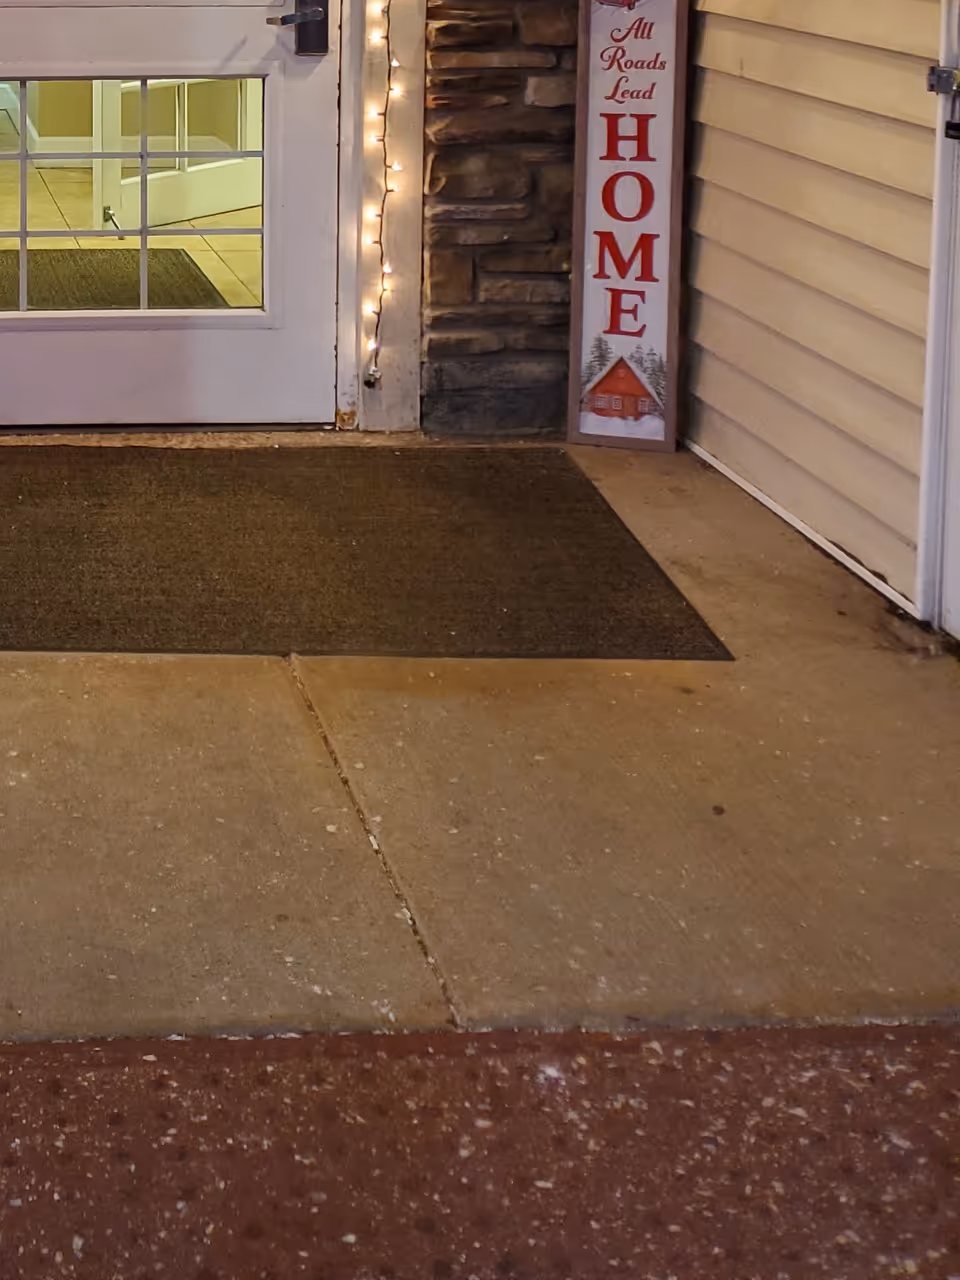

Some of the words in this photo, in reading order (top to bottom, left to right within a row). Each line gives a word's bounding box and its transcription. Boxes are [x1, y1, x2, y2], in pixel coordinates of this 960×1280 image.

[610, 16, 655, 43] All
[599, 45, 667, 72] Roads
[603, 75, 657, 105] Lead
[592, 112, 660, 339] HOME
